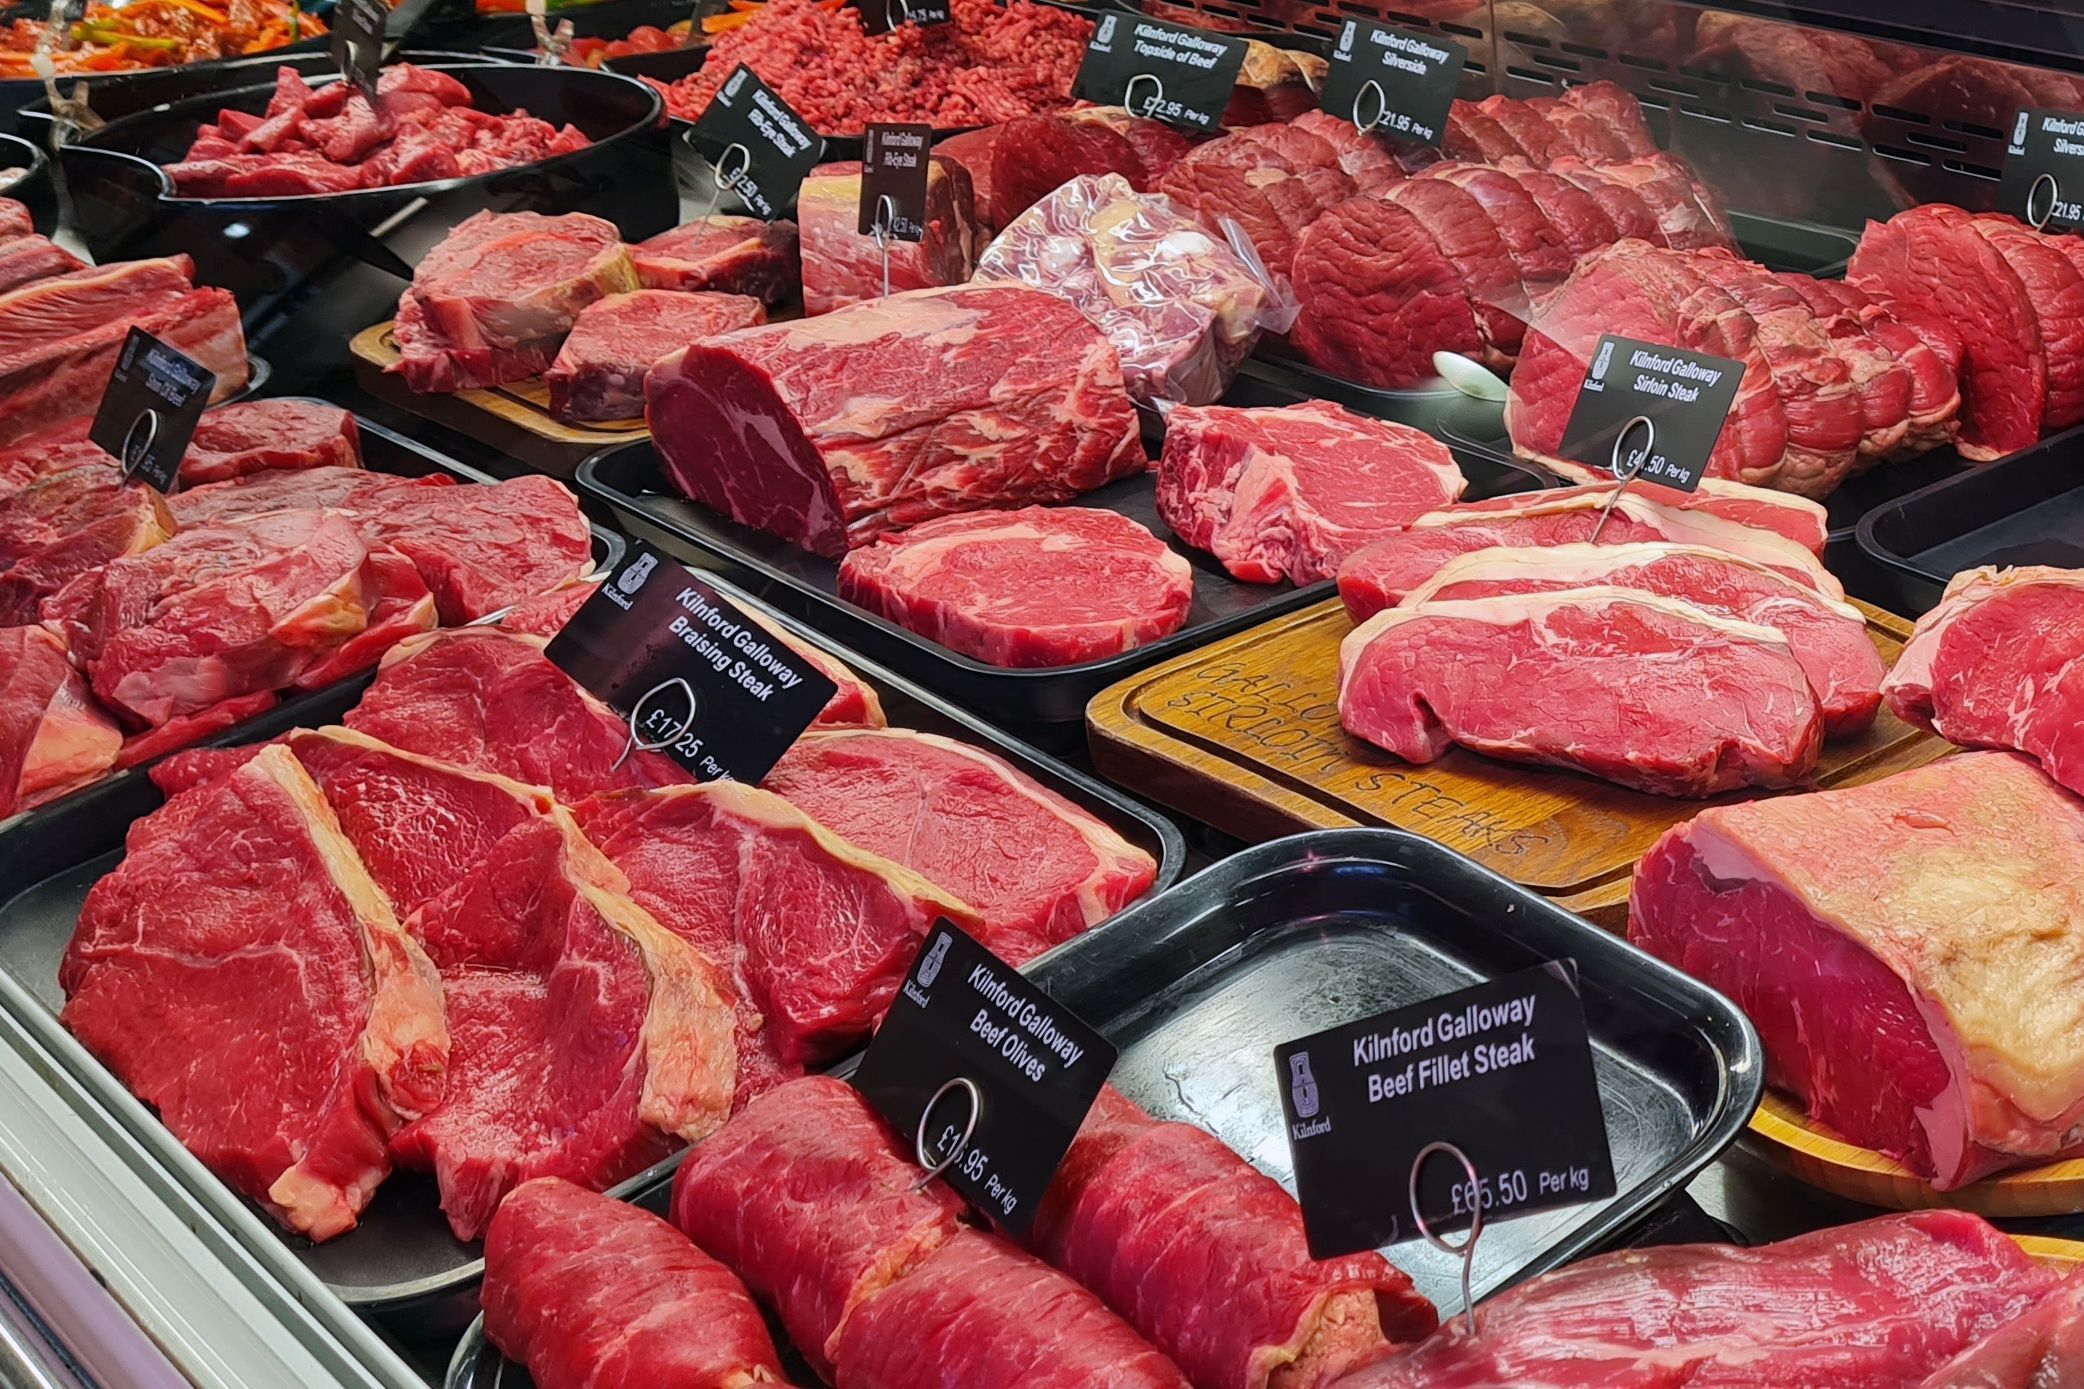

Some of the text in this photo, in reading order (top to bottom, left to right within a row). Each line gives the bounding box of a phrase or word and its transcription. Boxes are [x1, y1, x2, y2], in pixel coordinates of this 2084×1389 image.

[1134, 24, 1227, 57] Kilnford Galloway
[1134, 40, 1218, 69] Topside of Beef
[1370, 29, 1449, 64] Kilnford Galloway
[1382, 51, 1427, 75] Silverside
[1630, 350, 1722, 387] Kilnford Galloway
[1634, 375, 1699, 402] Sirloin Steak
[1665, 465, 1678, 478] Per
[1678, 467, 1690, 483] kg
[601, 583, 633, 610] Kilnford
[675, 587, 803, 689] Kilnford Galloway
[668, 616, 774, 702] Braising Steak
[699, 755, 723, 776] Per
[1355, 772, 1552, 856] STEAKS
[903, 983, 930, 1009] Kilnford
[968, 963, 1083, 1068] Kilnford Galloway
[1353, 993, 1536, 1067] Kilnford Galloway
[970, 1009, 1046, 1082] Beef Olives
[1368, 1034, 1536, 1103] Beef Fillet Steak
[1292, 1116, 1331, 1140] Kilnford
[984, 1173, 1006, 1200] Per
[1001, 1187, 1018, 1214] kg
[1451, 1166, 1590, 1215] £65.50 Per kg
